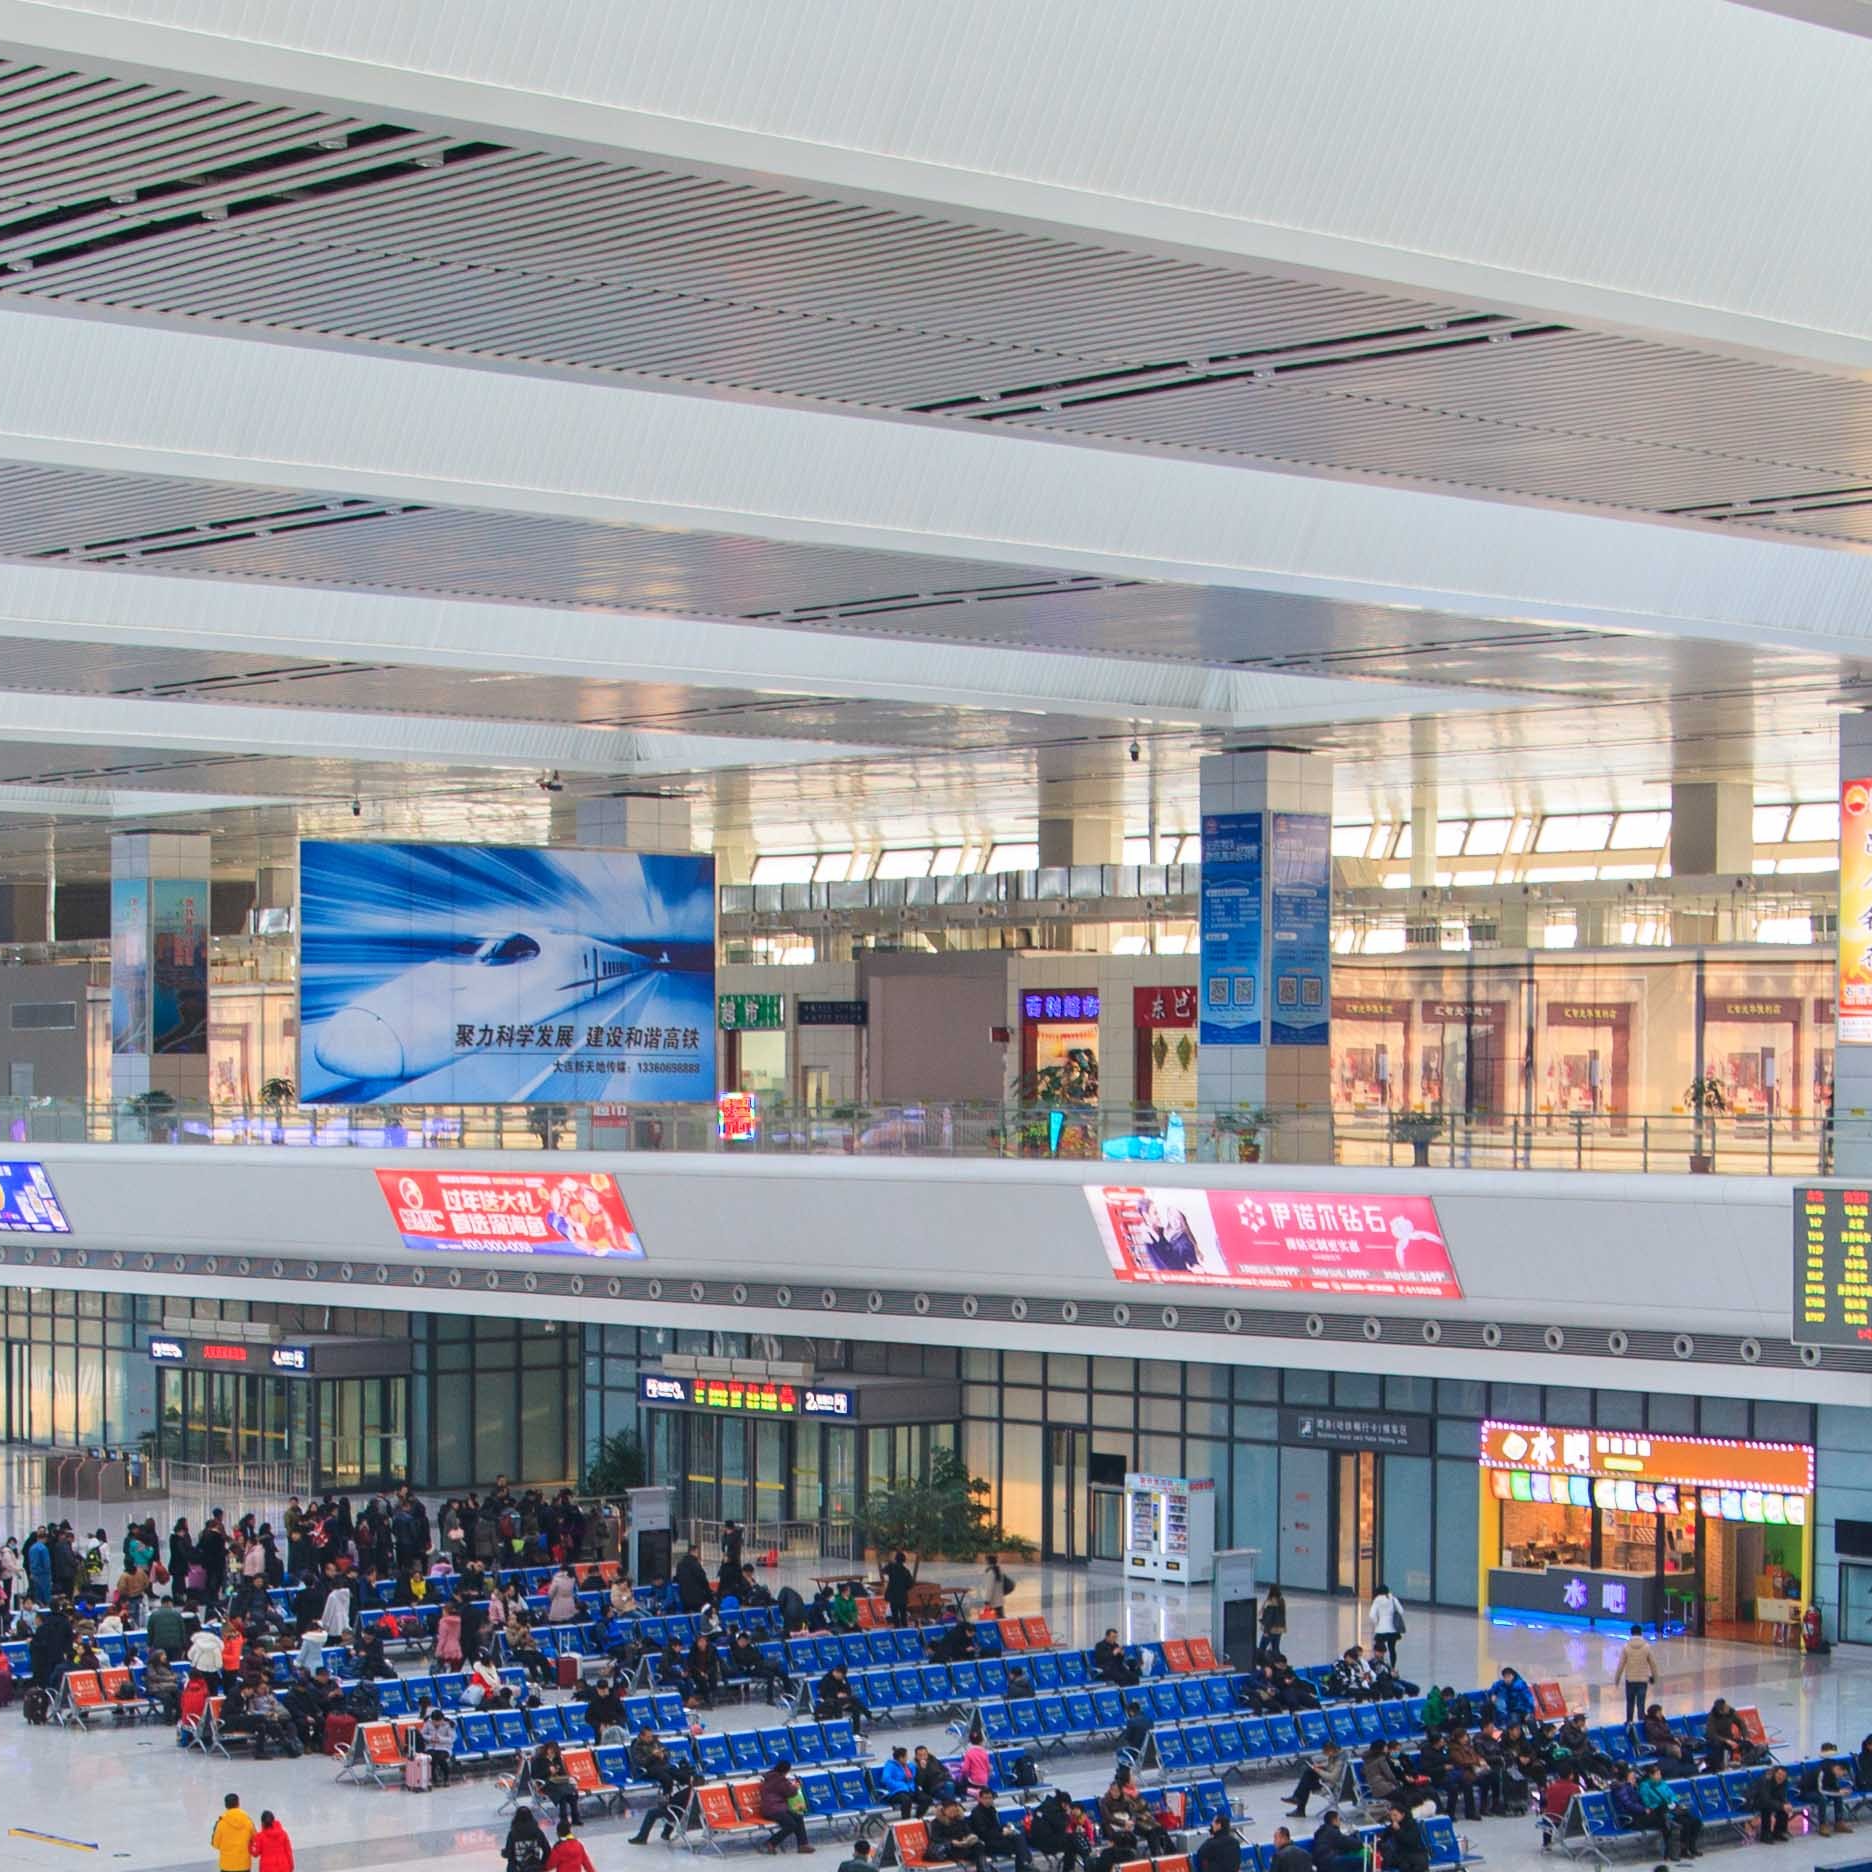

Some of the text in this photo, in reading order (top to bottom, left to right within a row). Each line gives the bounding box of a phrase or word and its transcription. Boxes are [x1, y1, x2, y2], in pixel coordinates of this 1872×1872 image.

[455, 1023, 701, 1050] 聚力科学发展 建设和谐高铁
[1563, 1578, 1626, 1614] 水吧
